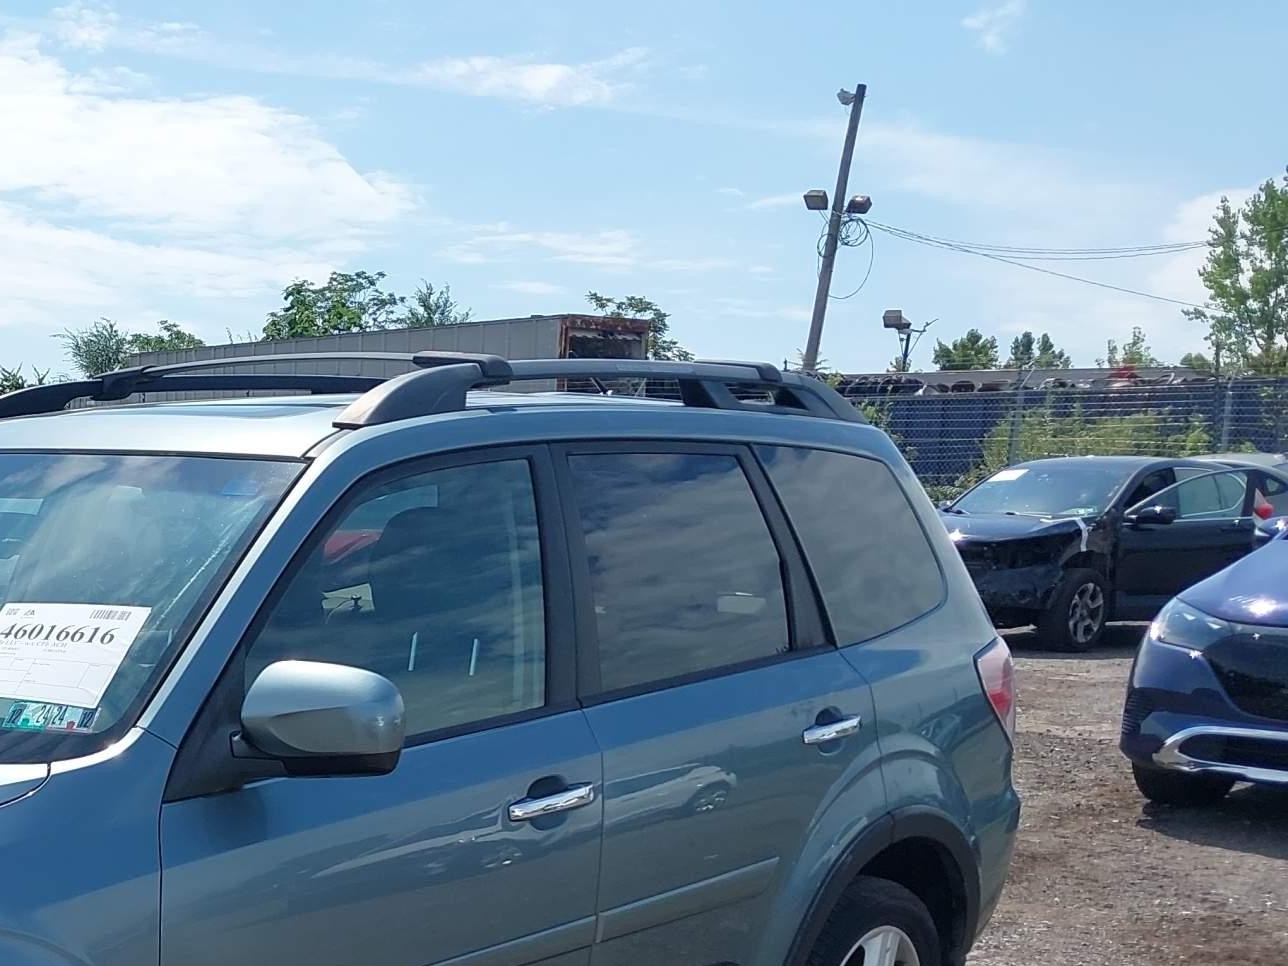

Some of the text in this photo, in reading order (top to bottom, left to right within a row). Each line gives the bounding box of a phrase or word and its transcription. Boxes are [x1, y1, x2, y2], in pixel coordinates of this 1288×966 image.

[0, 622, 120, 645] 46016616
[36, 705, 51, 725] 24
[52, 705, 69, 726] 24
